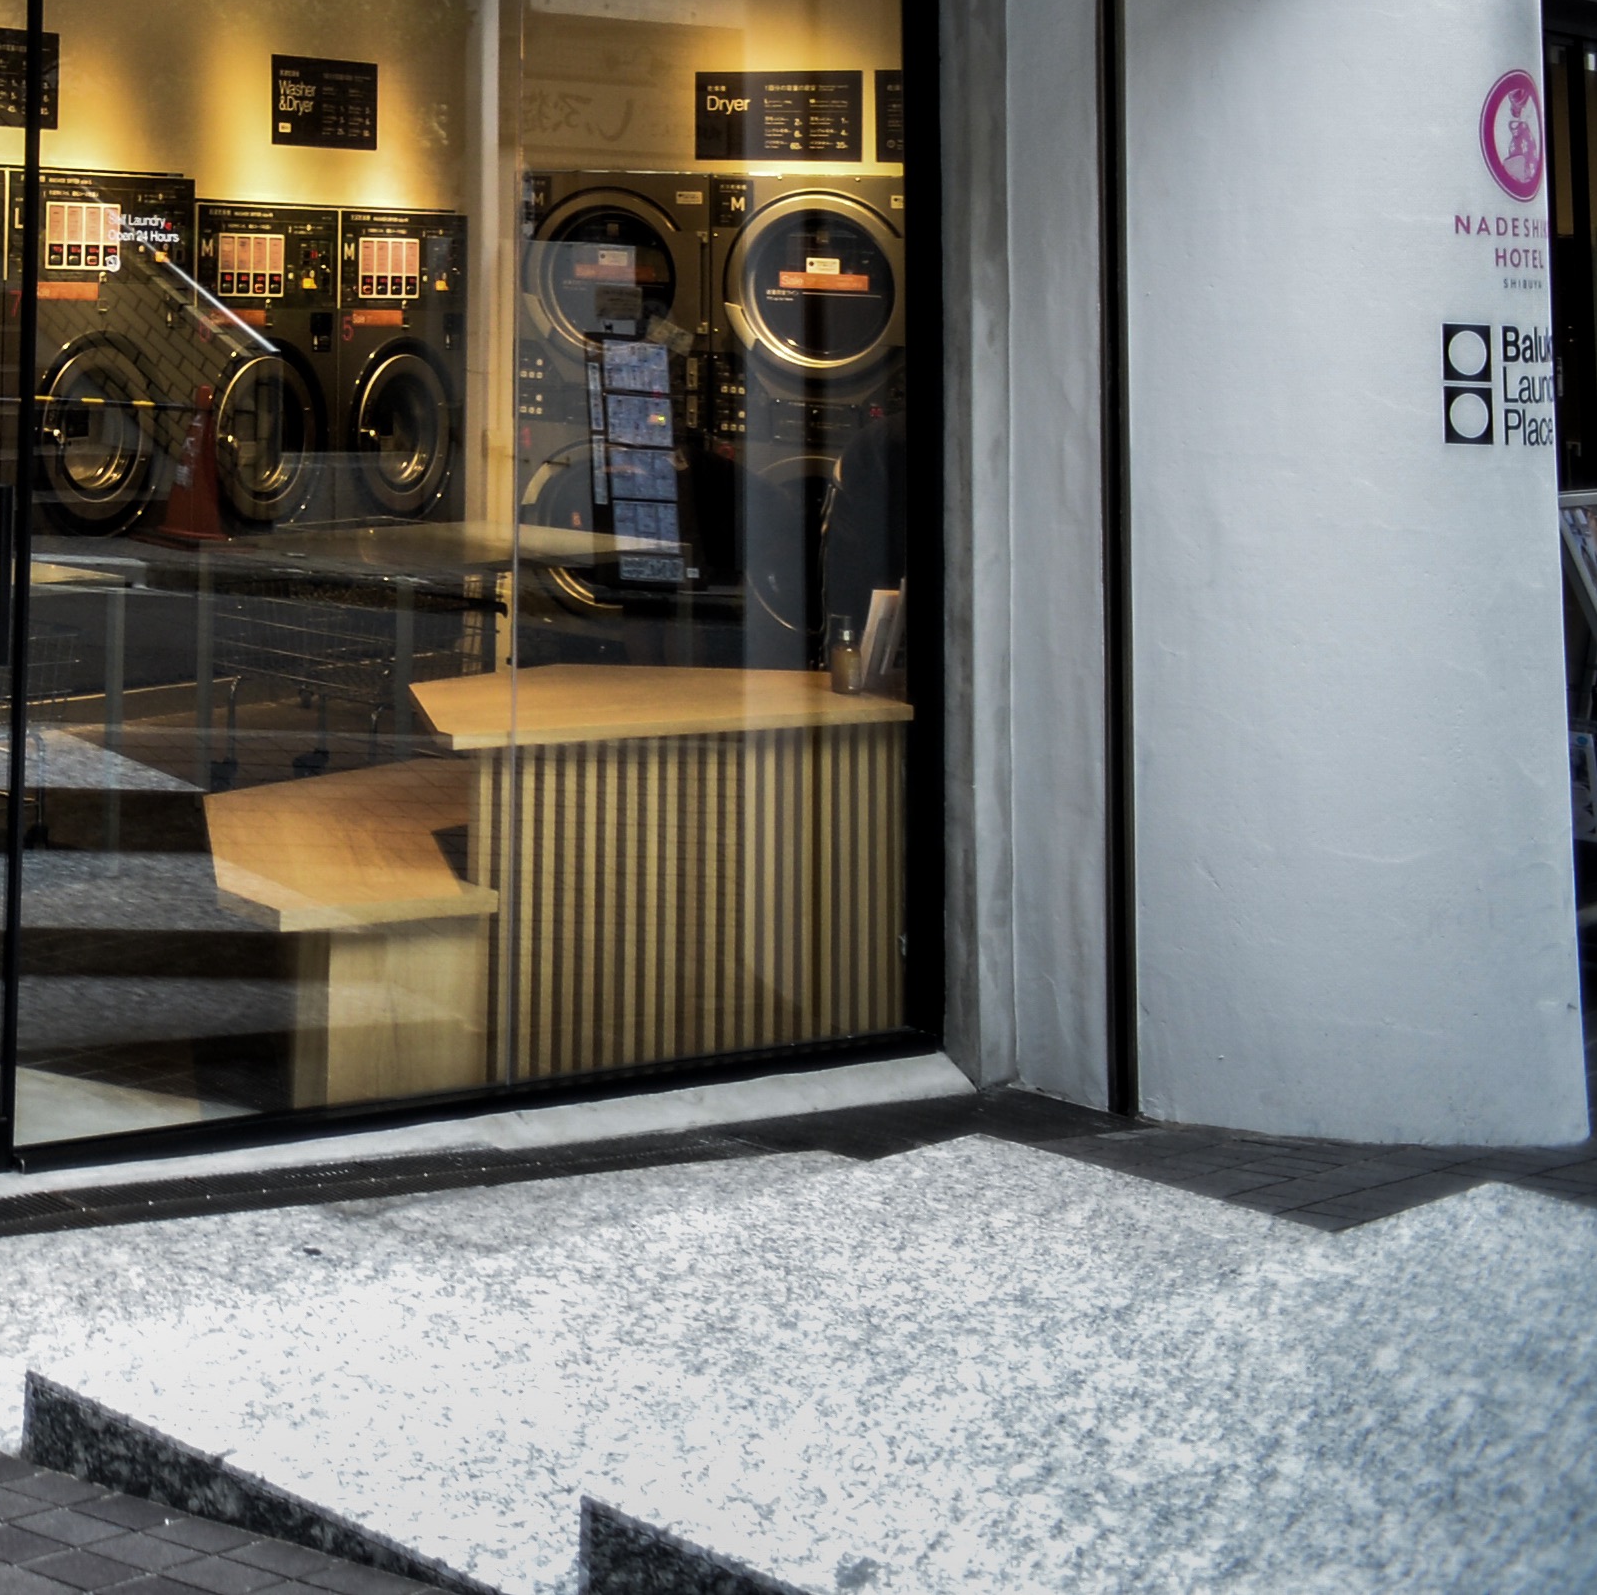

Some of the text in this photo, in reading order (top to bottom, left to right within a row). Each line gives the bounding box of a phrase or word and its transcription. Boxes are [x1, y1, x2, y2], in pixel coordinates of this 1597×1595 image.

[278, 79, 317, 97] Washer
[706, 95, 751, 115] Dryer
[1494, 247, 1544, 270] HOTEL
